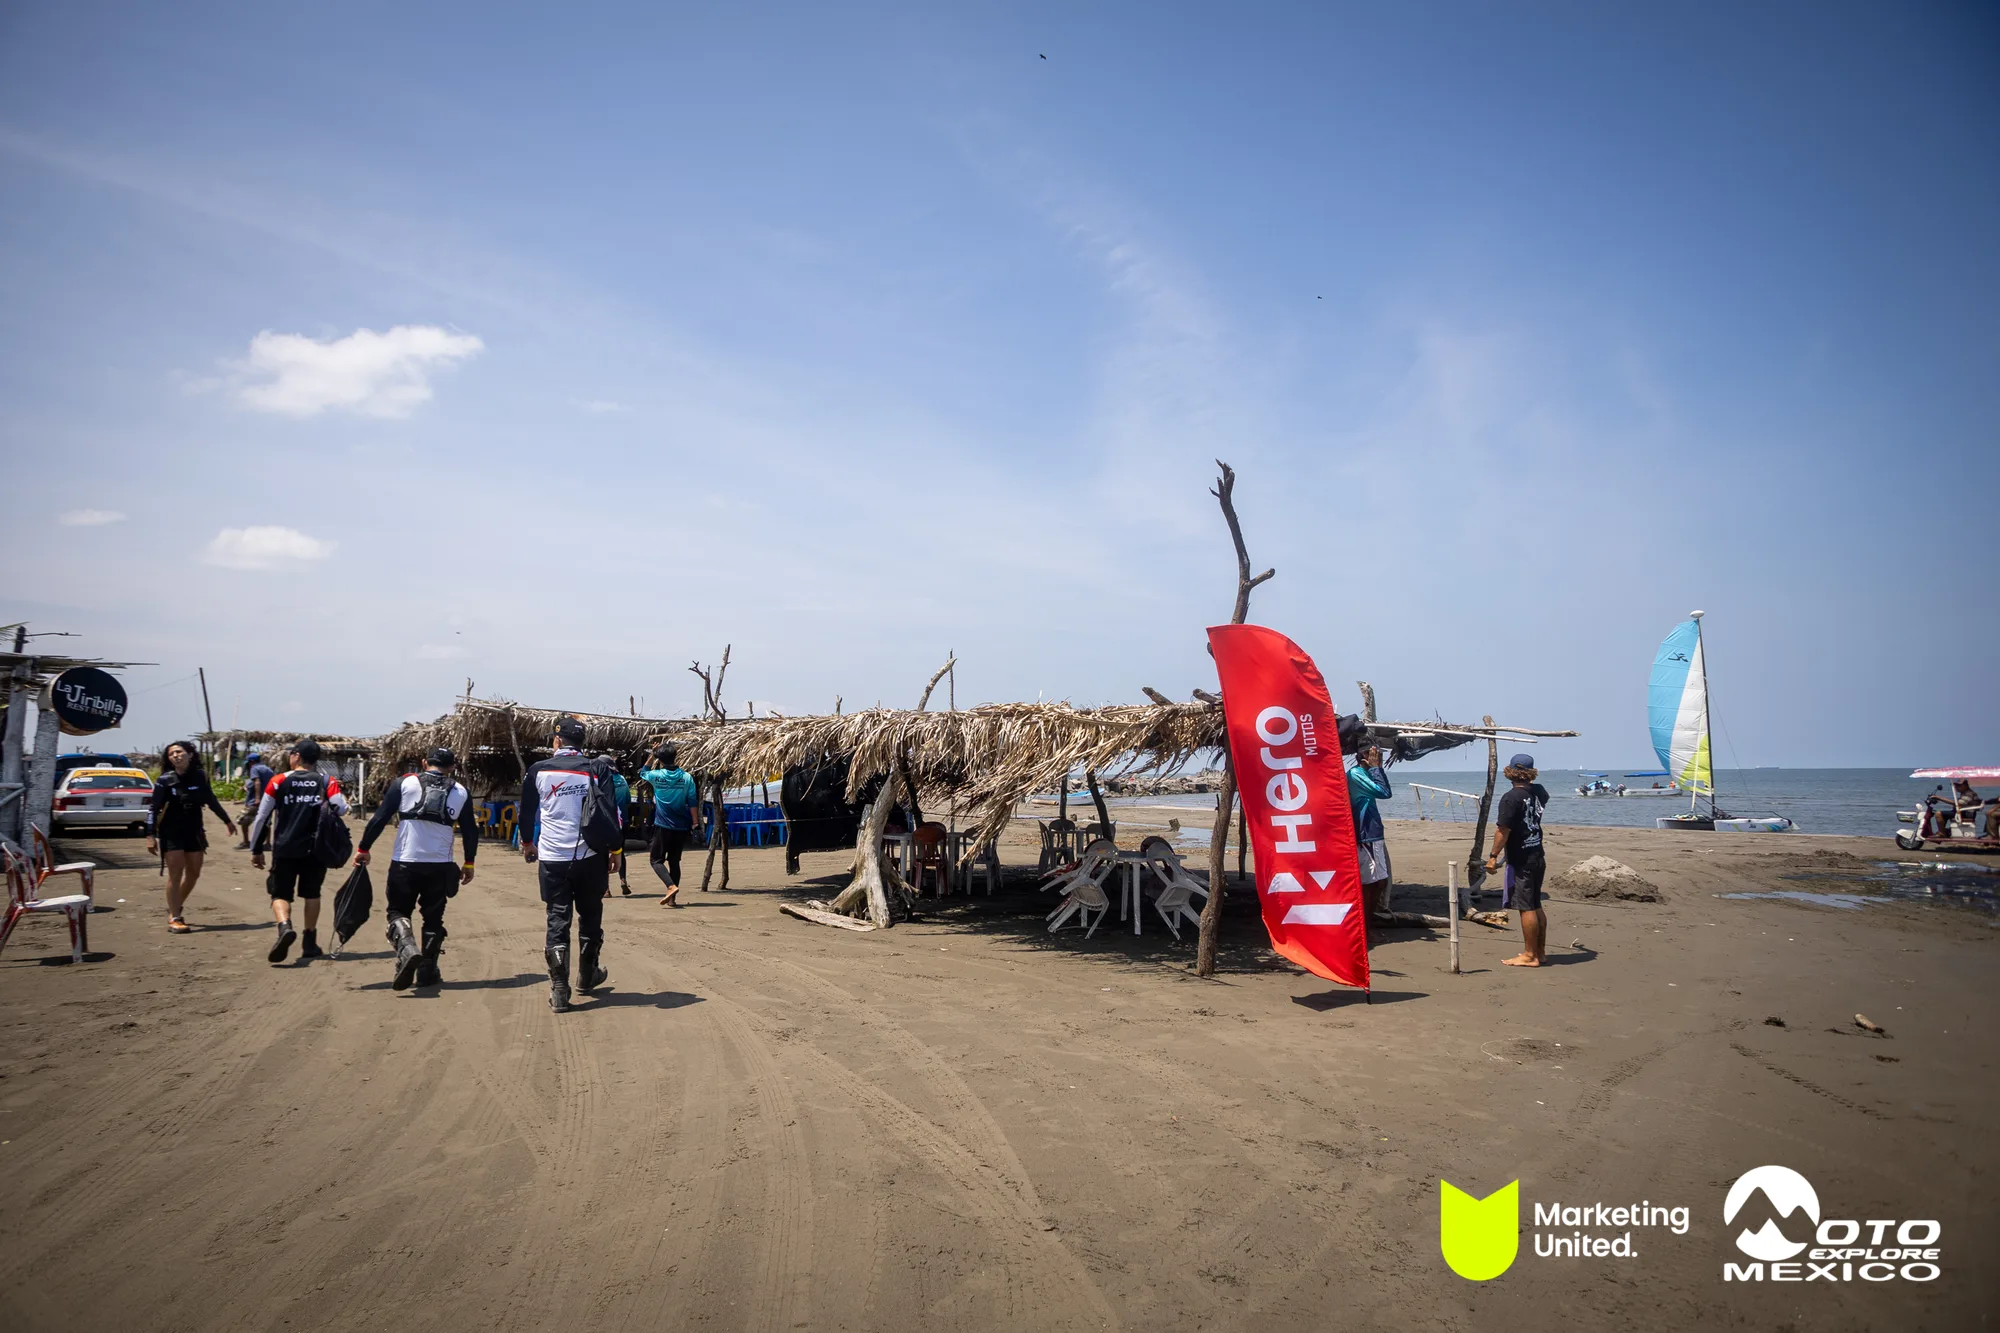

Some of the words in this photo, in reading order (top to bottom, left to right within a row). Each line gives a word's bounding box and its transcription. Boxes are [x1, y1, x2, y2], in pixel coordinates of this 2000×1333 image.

[56, 680, 72, 693] La
[66, 684, 123, 714] Jiribilla
[66, 701, 90, 713] REST
[90, 707, 109, 718] BAR
[1300, 713, 1318, 756] MOTOS
[557, 788, 588, 797] XPEDITIO
[1255, 705, 1317, 853] Hero
